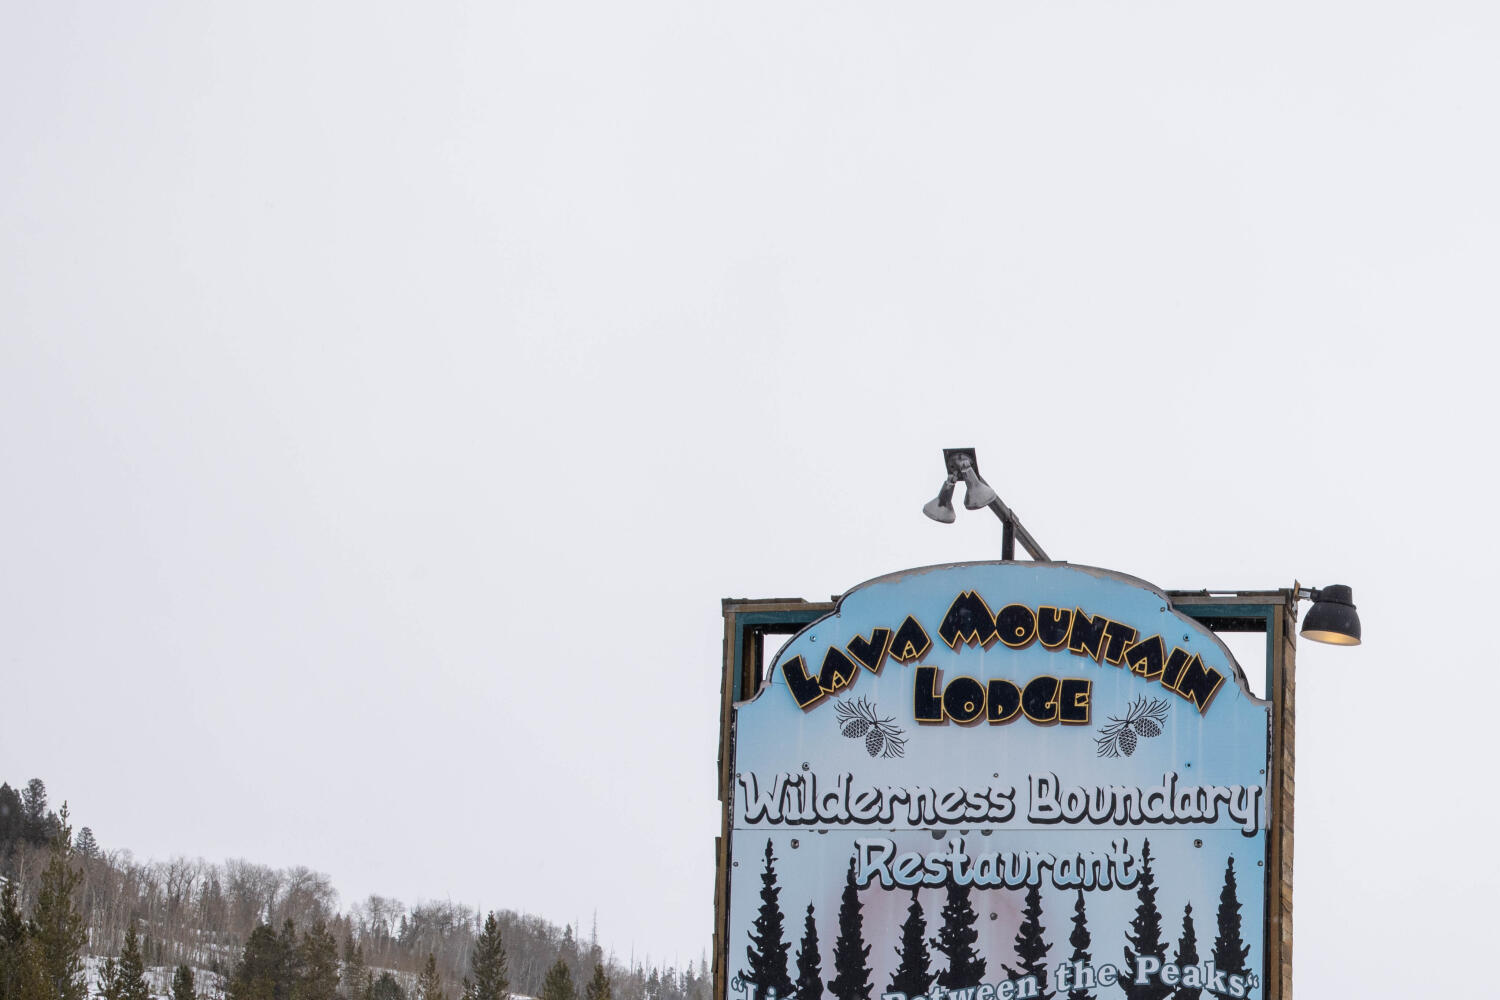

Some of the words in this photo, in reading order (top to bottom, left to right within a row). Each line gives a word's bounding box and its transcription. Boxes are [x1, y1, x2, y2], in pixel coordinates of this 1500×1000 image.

[781, 614, 931, 709] LAVA
[938, 590, 1225, 711] MOUNTAIN
[913, 666, 1092, 723] LODGE
[736, 771, 1017, 826] Wilderness
[1028, 770, 1262, 836] Boundary
[854, 837, 1143, 890] Restaurant
[1056, 960, 1118, 992] the
